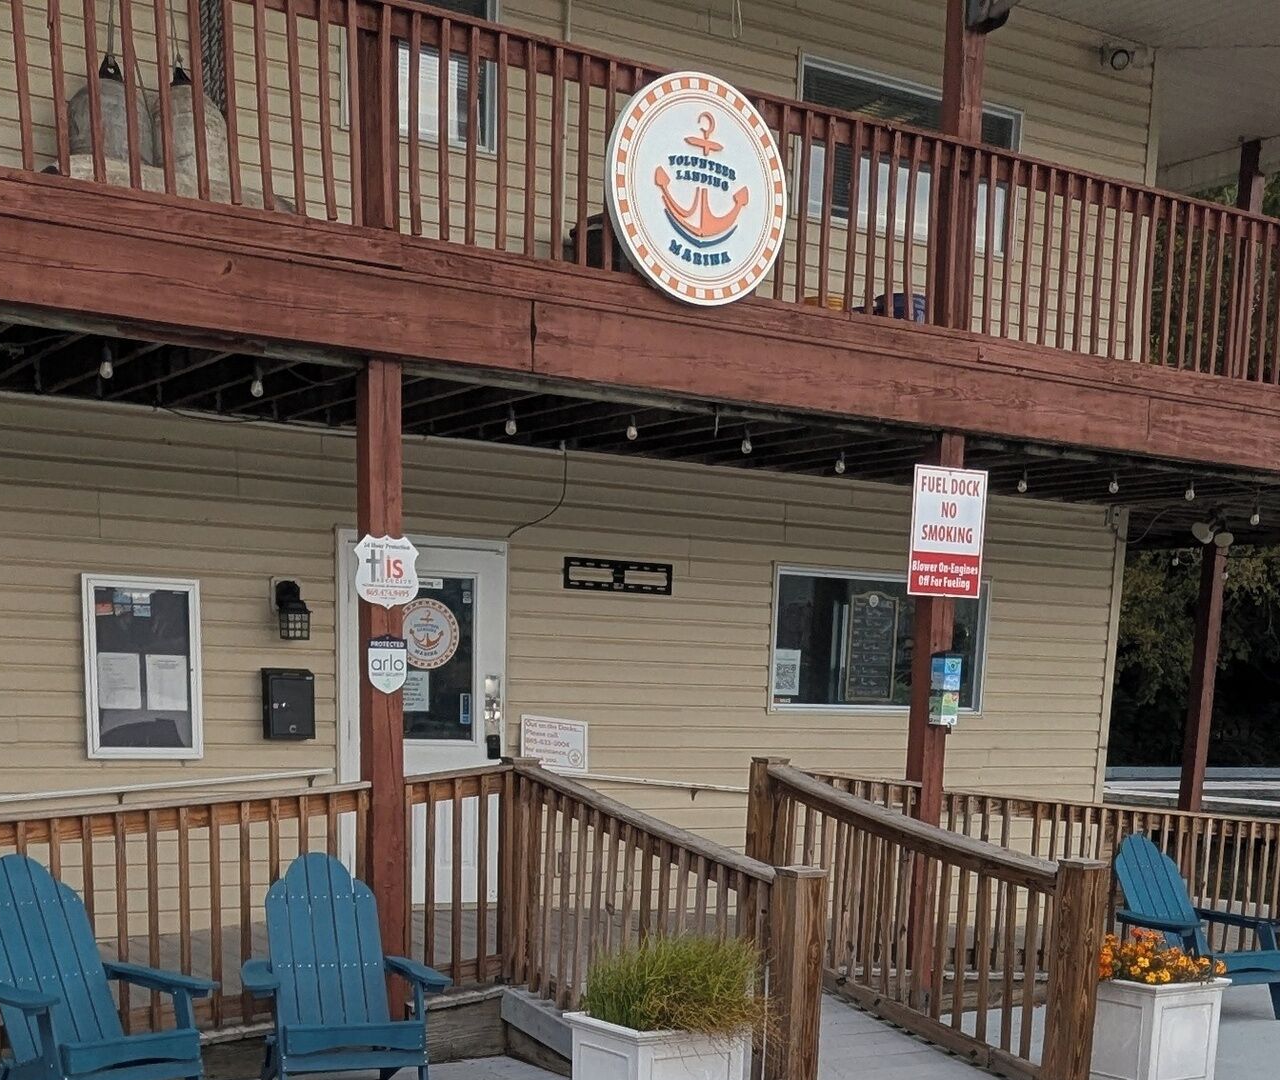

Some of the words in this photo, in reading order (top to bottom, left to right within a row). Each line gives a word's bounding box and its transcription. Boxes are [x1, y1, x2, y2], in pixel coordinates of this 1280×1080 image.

[668, 155, 736, 181] VOLUNTEER
[676, 170, 729, 191] LANDING
[669, 239, 731, 266] MARINA
[921, 476, 948, 494] FUEL
[951, 478, 980, 497] DOCK
[941, 501, 957, 519] NO
[921, 524, 973, 544] SMOKING
[912, 560, 937, 572] Blower
[918, 575, 929, 586] Off
[930, 576, 942, 587] For
[943, 577, 970, 591] Fueling
[370, 640, 405, 648] PROTECTED
[371, 654, 404, 671] arlo
